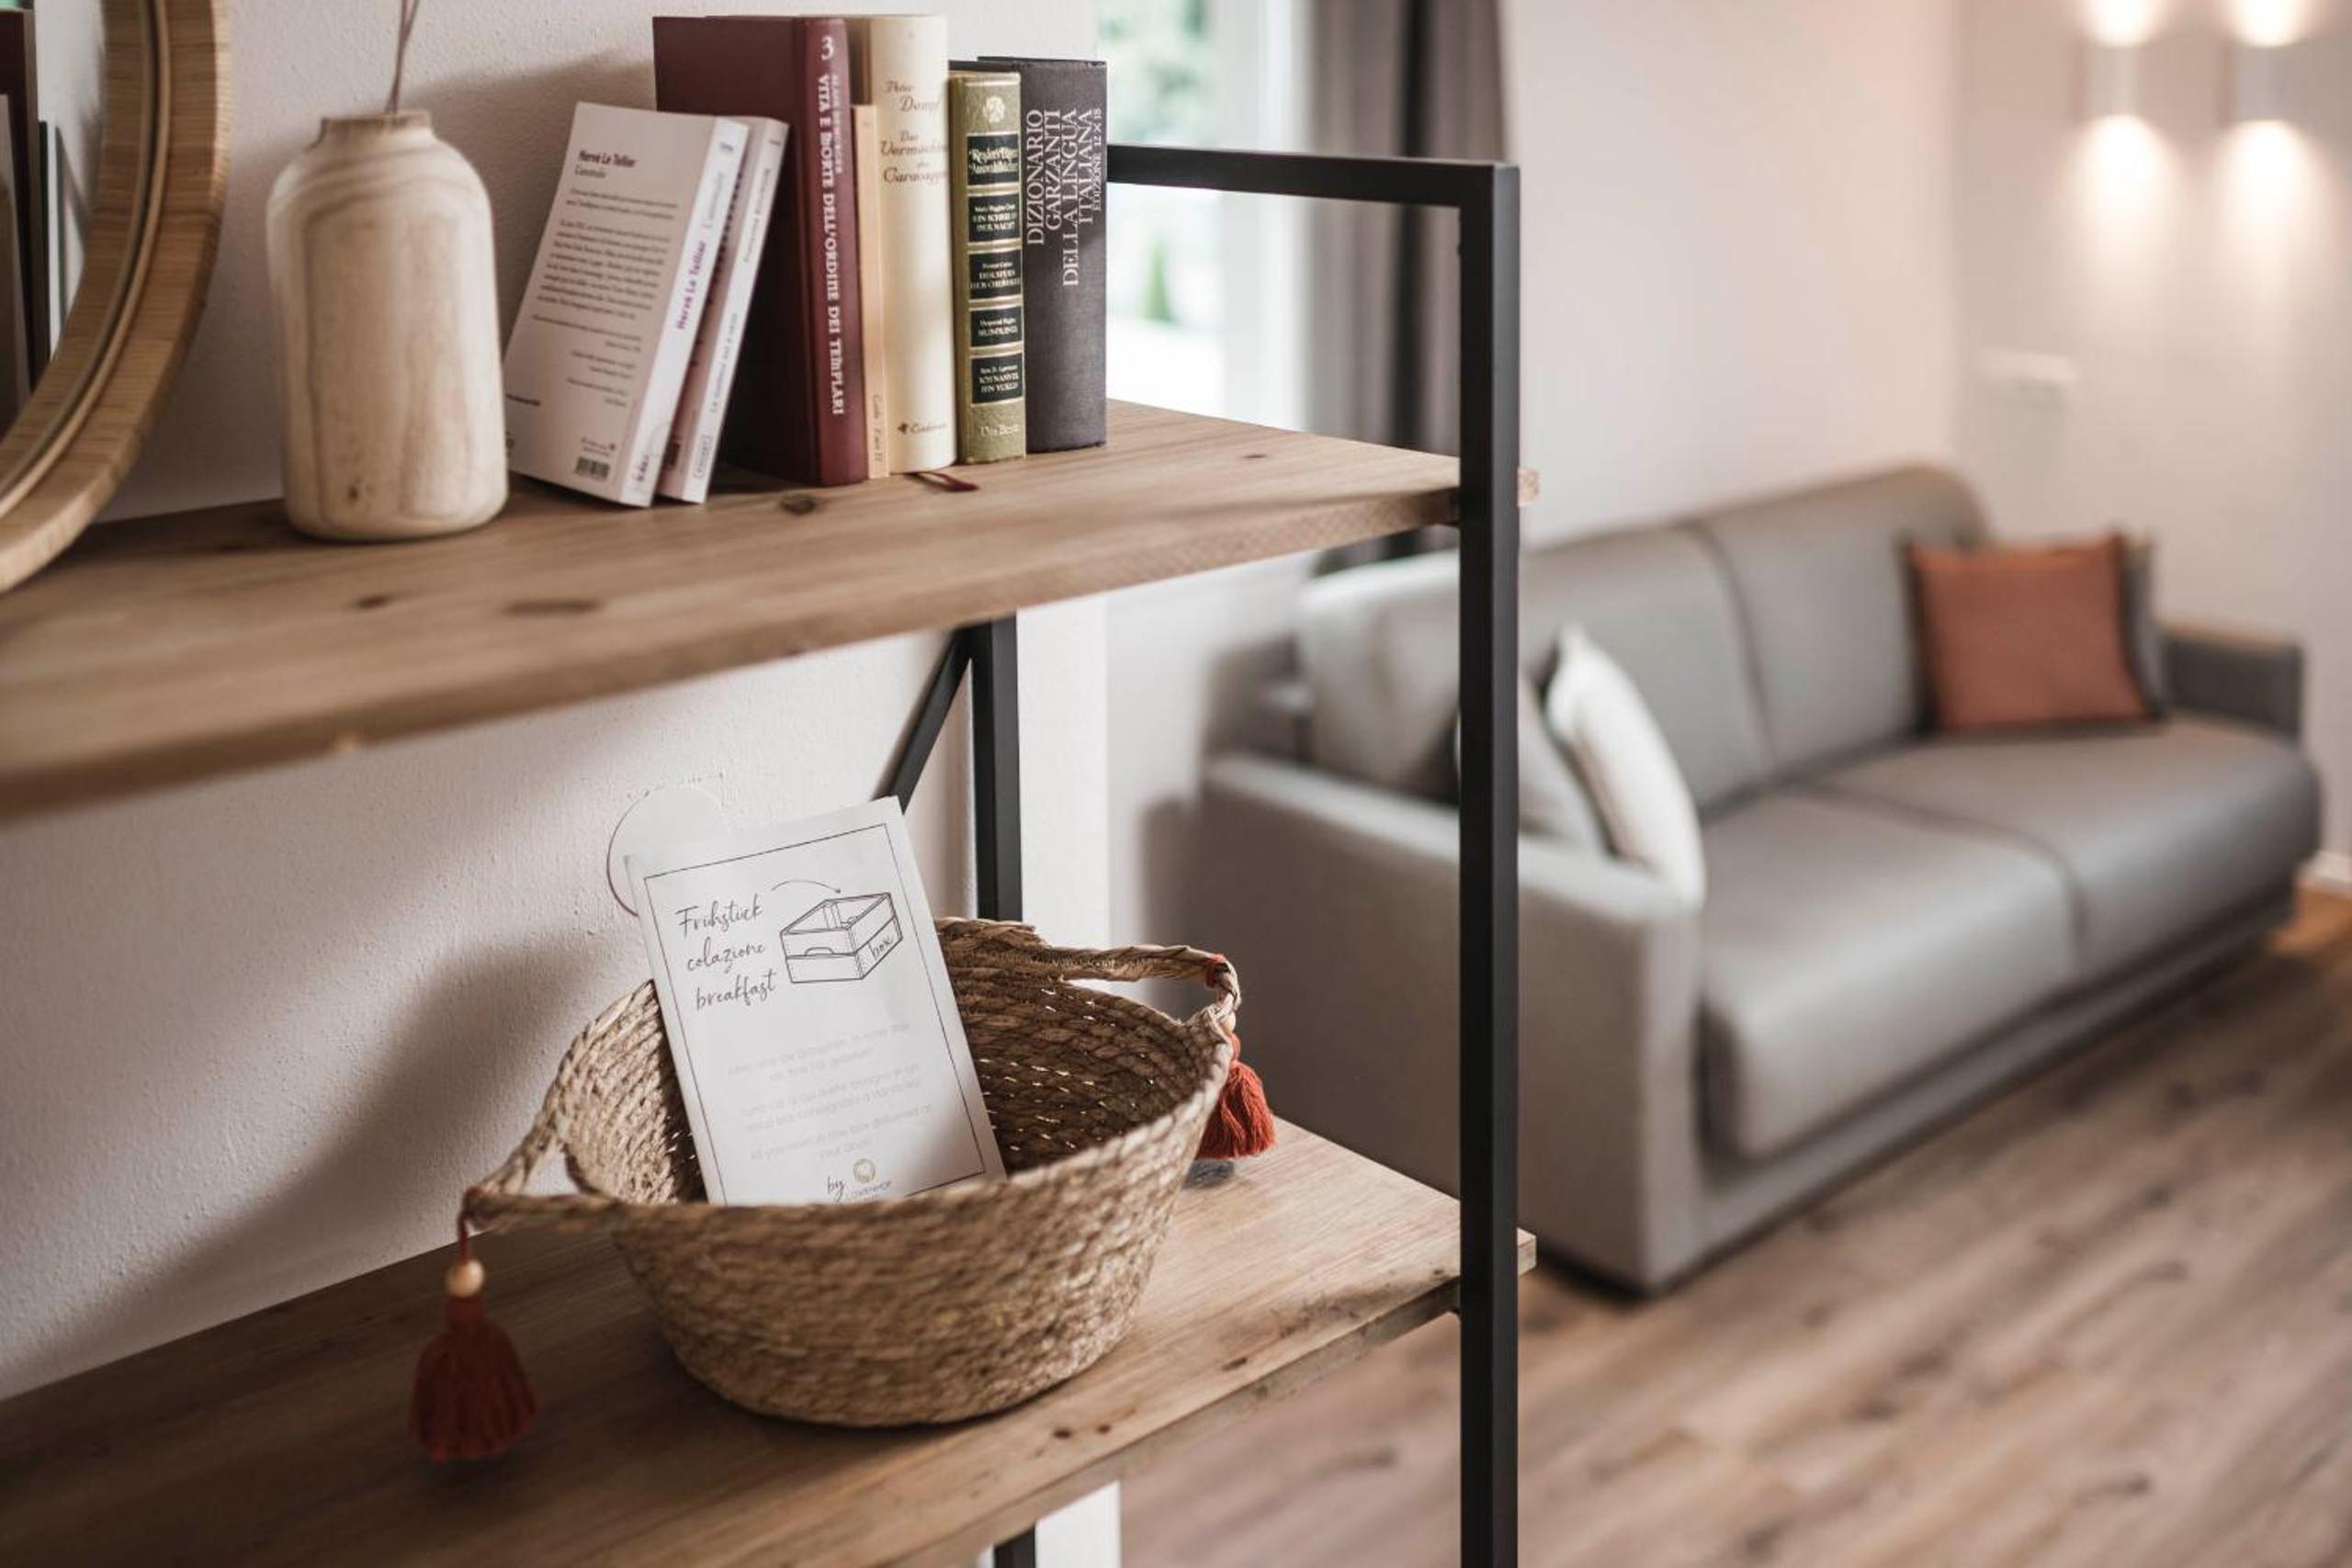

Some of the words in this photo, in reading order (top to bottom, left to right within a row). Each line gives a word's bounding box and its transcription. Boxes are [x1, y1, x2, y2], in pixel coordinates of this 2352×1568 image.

[818, 73, 831, 112] VITA
[820, 117, 831, 127] E
[1026, 109, 1044, 244] DIZIONARIO
[1044, 109, 1061, 231] GARZANTI
[1061, 108, 1078, 201] LINGUA
[1078, 108, 1093, 224] ITALIANA
[1062, 208, 1079, 287] DELLA
[828, 305, 841, 333] DEI
[687, 935, 764, 974] colazione
[696, 967, 776, 1011] breakfast
